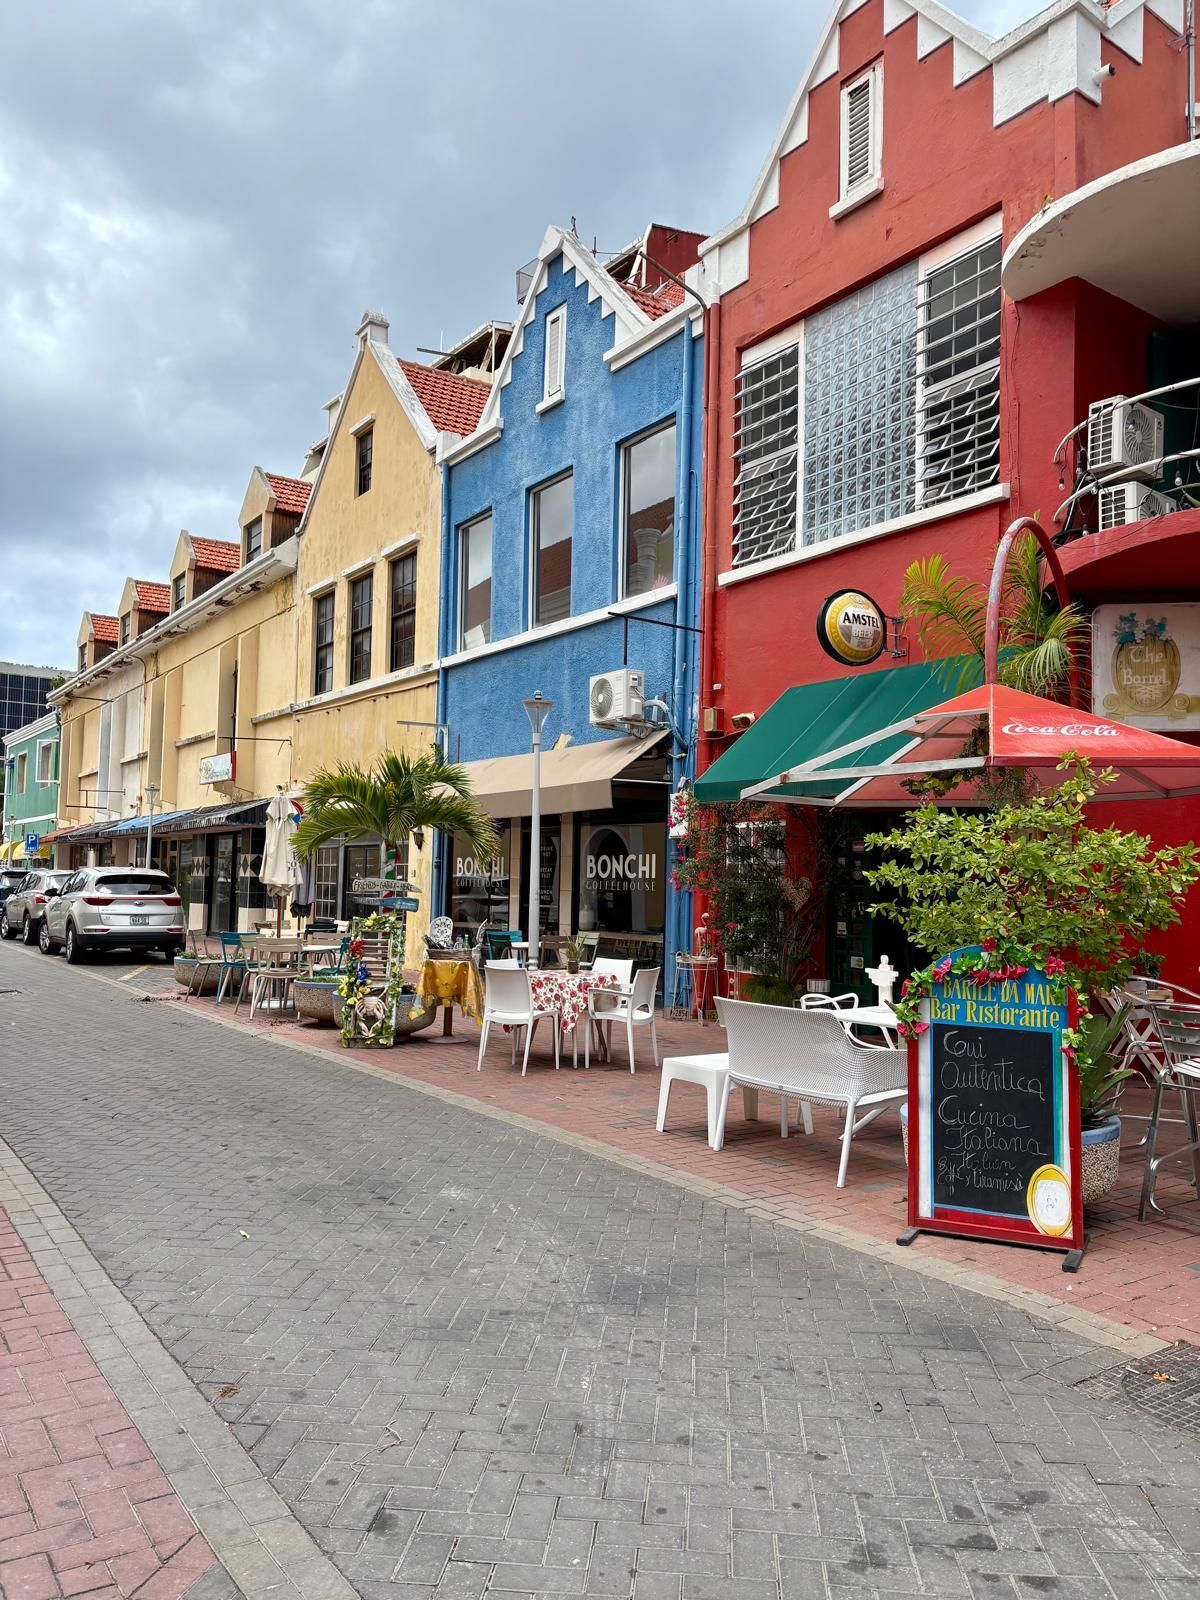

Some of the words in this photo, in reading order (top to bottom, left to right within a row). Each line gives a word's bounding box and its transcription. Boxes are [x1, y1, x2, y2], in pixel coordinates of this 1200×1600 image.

[842, 611, 880, 629] AMSTEL
[1129, 645, 1164, 664] The
[1122, 667, 1169, 686] Barrel
[1001, 723, 1120, 737] Coca-Cola
[28, 835, 36, 844] P
[456, 856, 504, 878] BONCHI
[587, 853, 657, 879] BONCHI
[586, 880, 656, 892] COFFEEHOUSE
[1001, 981, 1019, 1003] DA
[930, 998, 961, 1021] Bar
[966, 1001, 1060, 1028] Ristorante
[938, 1095, 1031, 1129] Cucina
[944, 1125, 1048, 1156] Italiana
